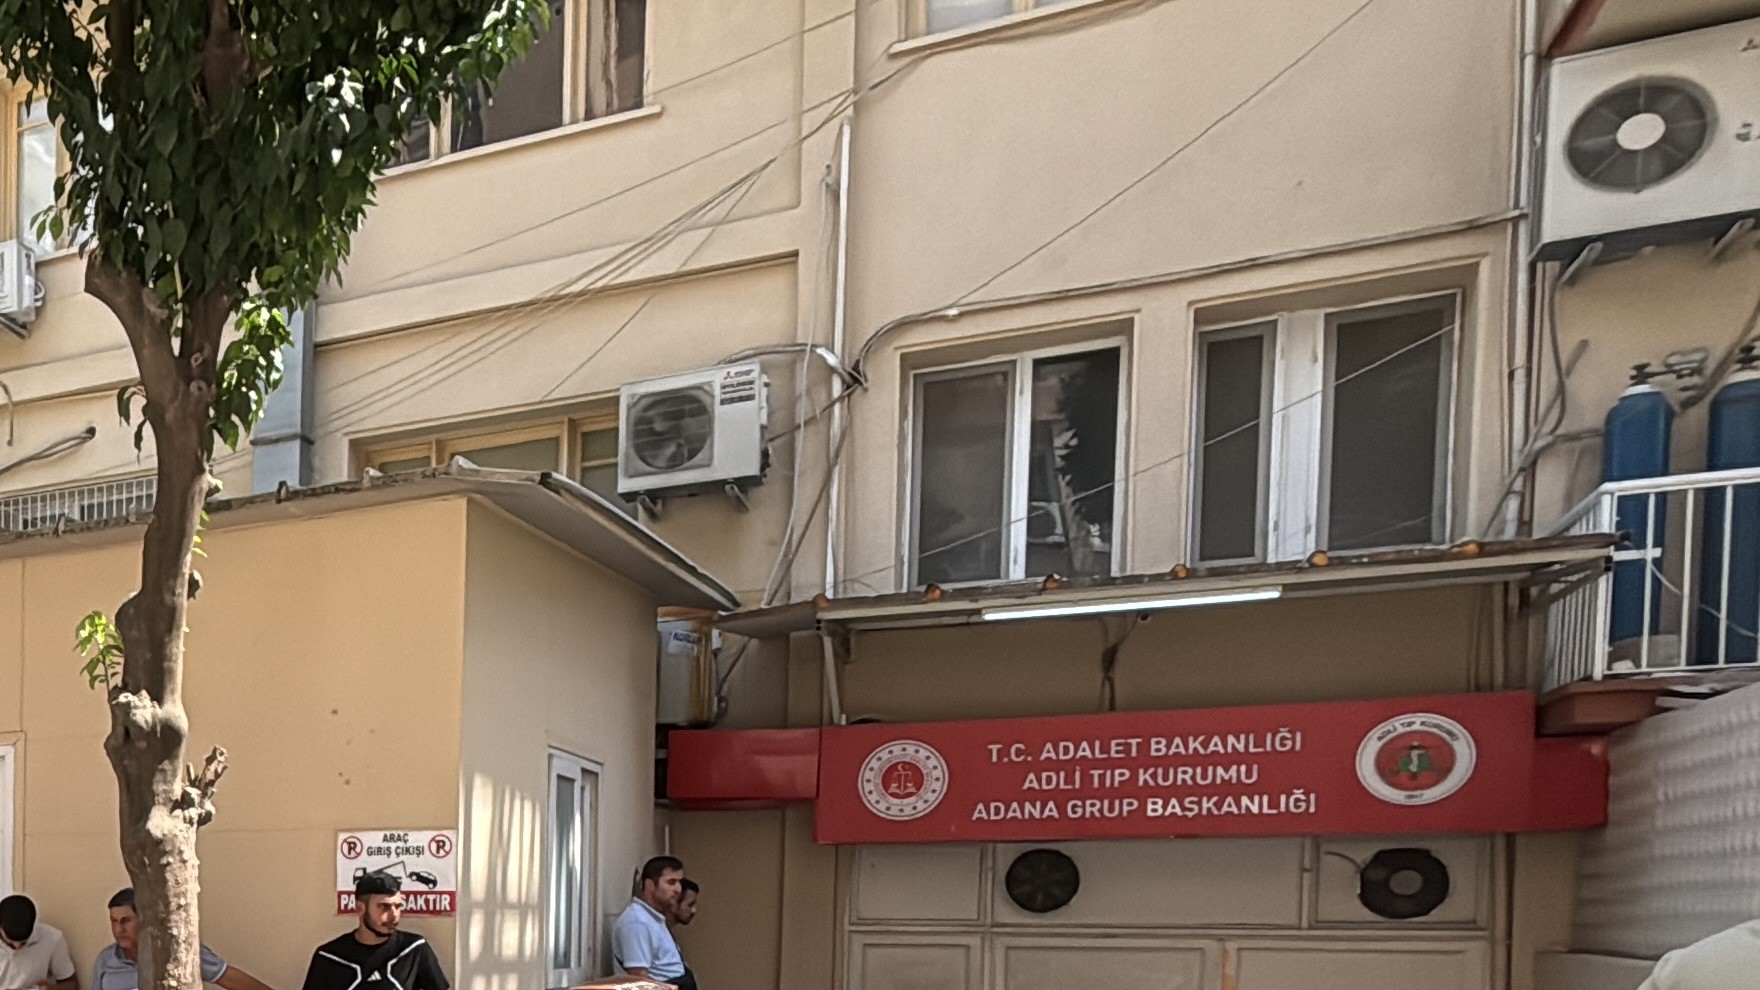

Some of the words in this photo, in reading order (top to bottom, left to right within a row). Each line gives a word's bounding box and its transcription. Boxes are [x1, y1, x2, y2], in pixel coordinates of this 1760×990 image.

[986, 743, 1032, 763] T.C.
[1039, 738, 1143, 761] ADALET
[1149, 727, 1302, 757] BAKANLIĞI
[1022, 765, 1081, 790] ADLİ
[1089, 768, 1131, 788] TIP
[1138, 763, 1259, 787] KURUMU
[971, 801, 1060, 821] ADANA
[1066, 798, 1139, 819] GRUP
[1146, 788, 1317, 819] BAŞKANLIĞI
[366, 845, 391, 859] GİRİŞ
[382, 833, 410, 844] ARAÇ
